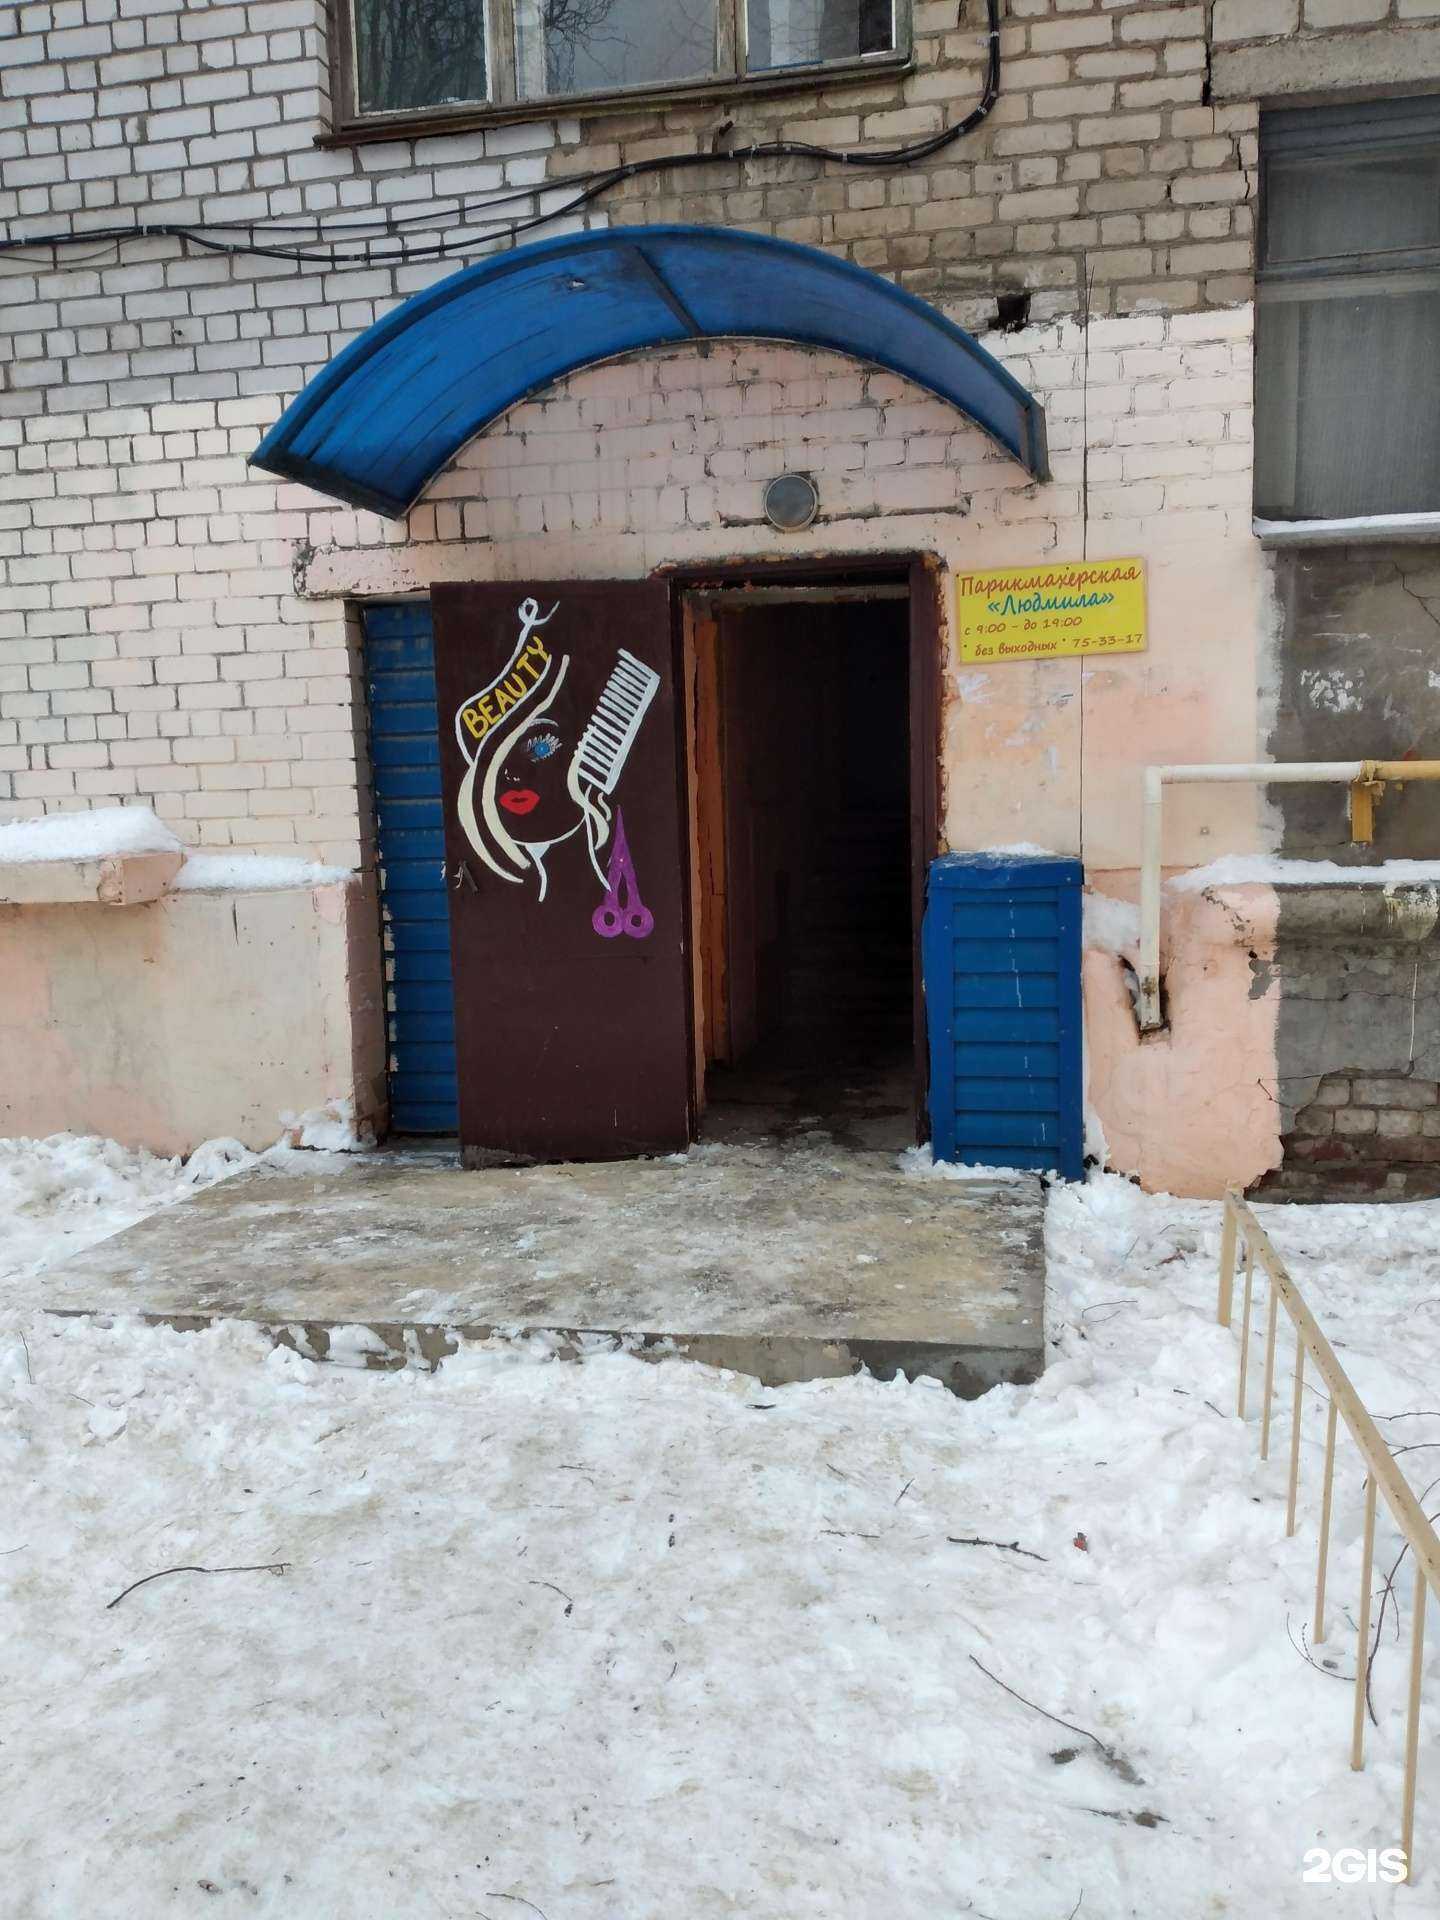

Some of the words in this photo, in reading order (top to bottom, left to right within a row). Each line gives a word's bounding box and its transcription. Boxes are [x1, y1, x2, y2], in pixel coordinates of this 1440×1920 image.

[961, 565, 1141, 599] Парикмахерская
[987, 592, 1115, 616] «Людмила»
[976, 622, 1006, 634] 9:00
[1023, 619, 1037, 631] до
[1043, 616, 1083, 629] 19:00
[975, 643, 994, 657] без
[999, 640, 1057, 655] выходных
[1073, 633, 1143, 649] 75-33-17
[462, 636, 549, 739] BEAUTY
